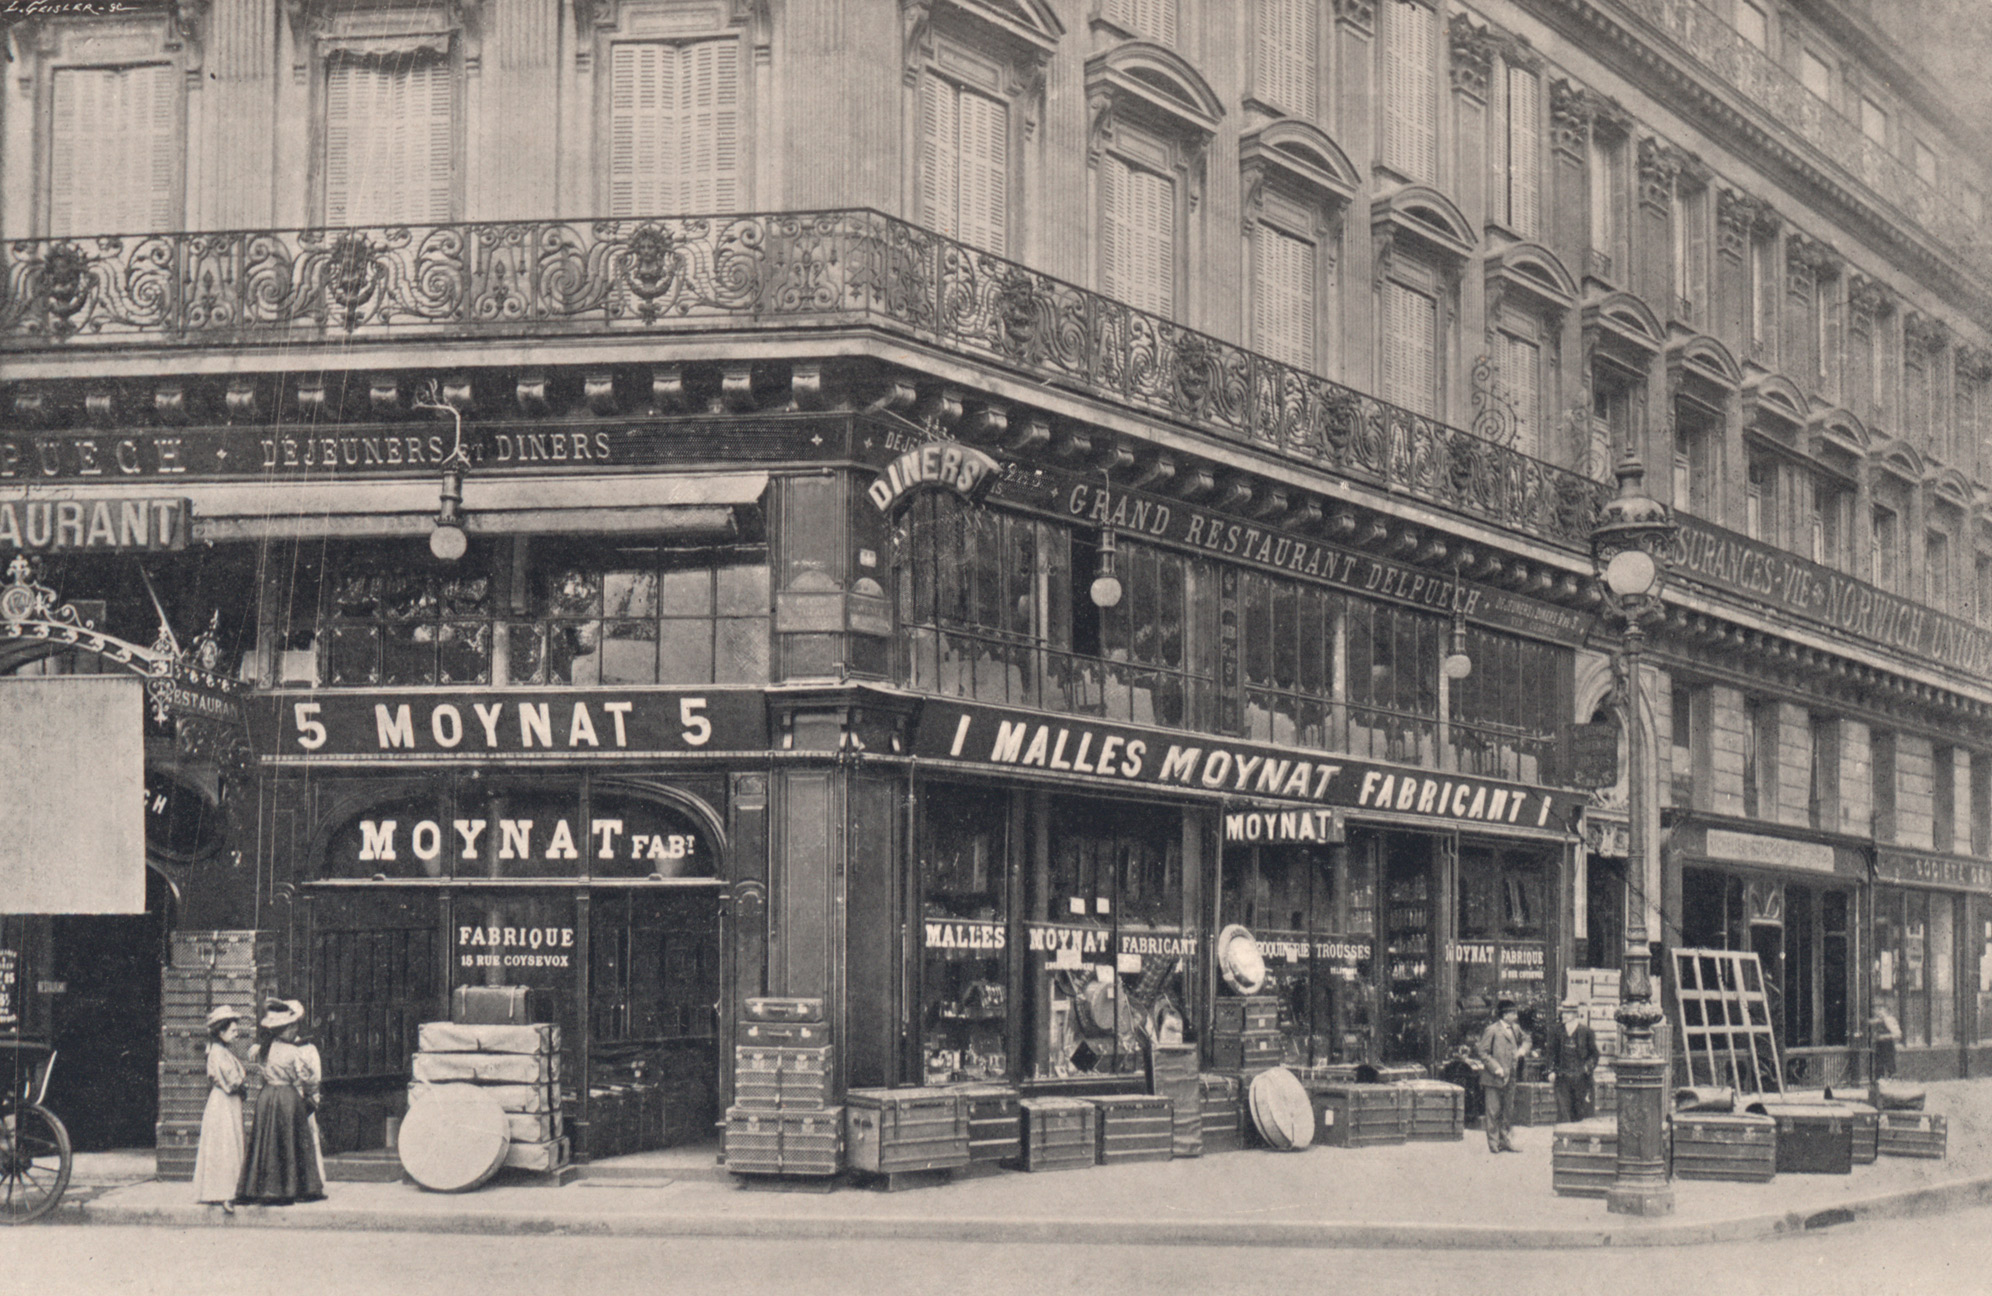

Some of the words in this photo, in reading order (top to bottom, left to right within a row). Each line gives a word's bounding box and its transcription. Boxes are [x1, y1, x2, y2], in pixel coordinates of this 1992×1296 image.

[260, 434, 443, 467] DÉJEUNERS
[496, 432, 611, 461] DINERS
[868, 446, 981, 511] DINERS
[0, 499, 179, 548] AURANT
[1068, 484, 1170, 534] GRAND
[1185, 514, 1357, 585] RESTAURANT
[1365, 562, 1482, 615] DELPUECH
[1782, 562, 1814, 609] VIE
[1824, 574, 1926, 651] NORWICH
[293, 702, 327, 750] 5
[374, 700, 633, 749] MOYNAT
[680, 697, 712, 745] 5
[990, 720, 1146, 779] MALLES
[1158, 745, 1342, 799] MOYNAT
[1358, 771, 1526, 824] FABRICANT
[358, 818, 624, 862] MOYNAT
[1226, 809, 1332, 843] MOYNAT
[458, 925, 575, 950] FABRIQUE
[924, 923, 1006, 949] MALLES
[1029, 928, 1110, 953] MOYNAT
[1121, 936, 1198, 956] FABRICANT
[1316, 943, 1371, 960] TROUSSES
[460, 954, 474, 967] 15
[476, 954, 501, 967] RUE
[503, 954, 569, 967] COYSEVOX
[1501, 949, 1544, 965] FABRIQUE
